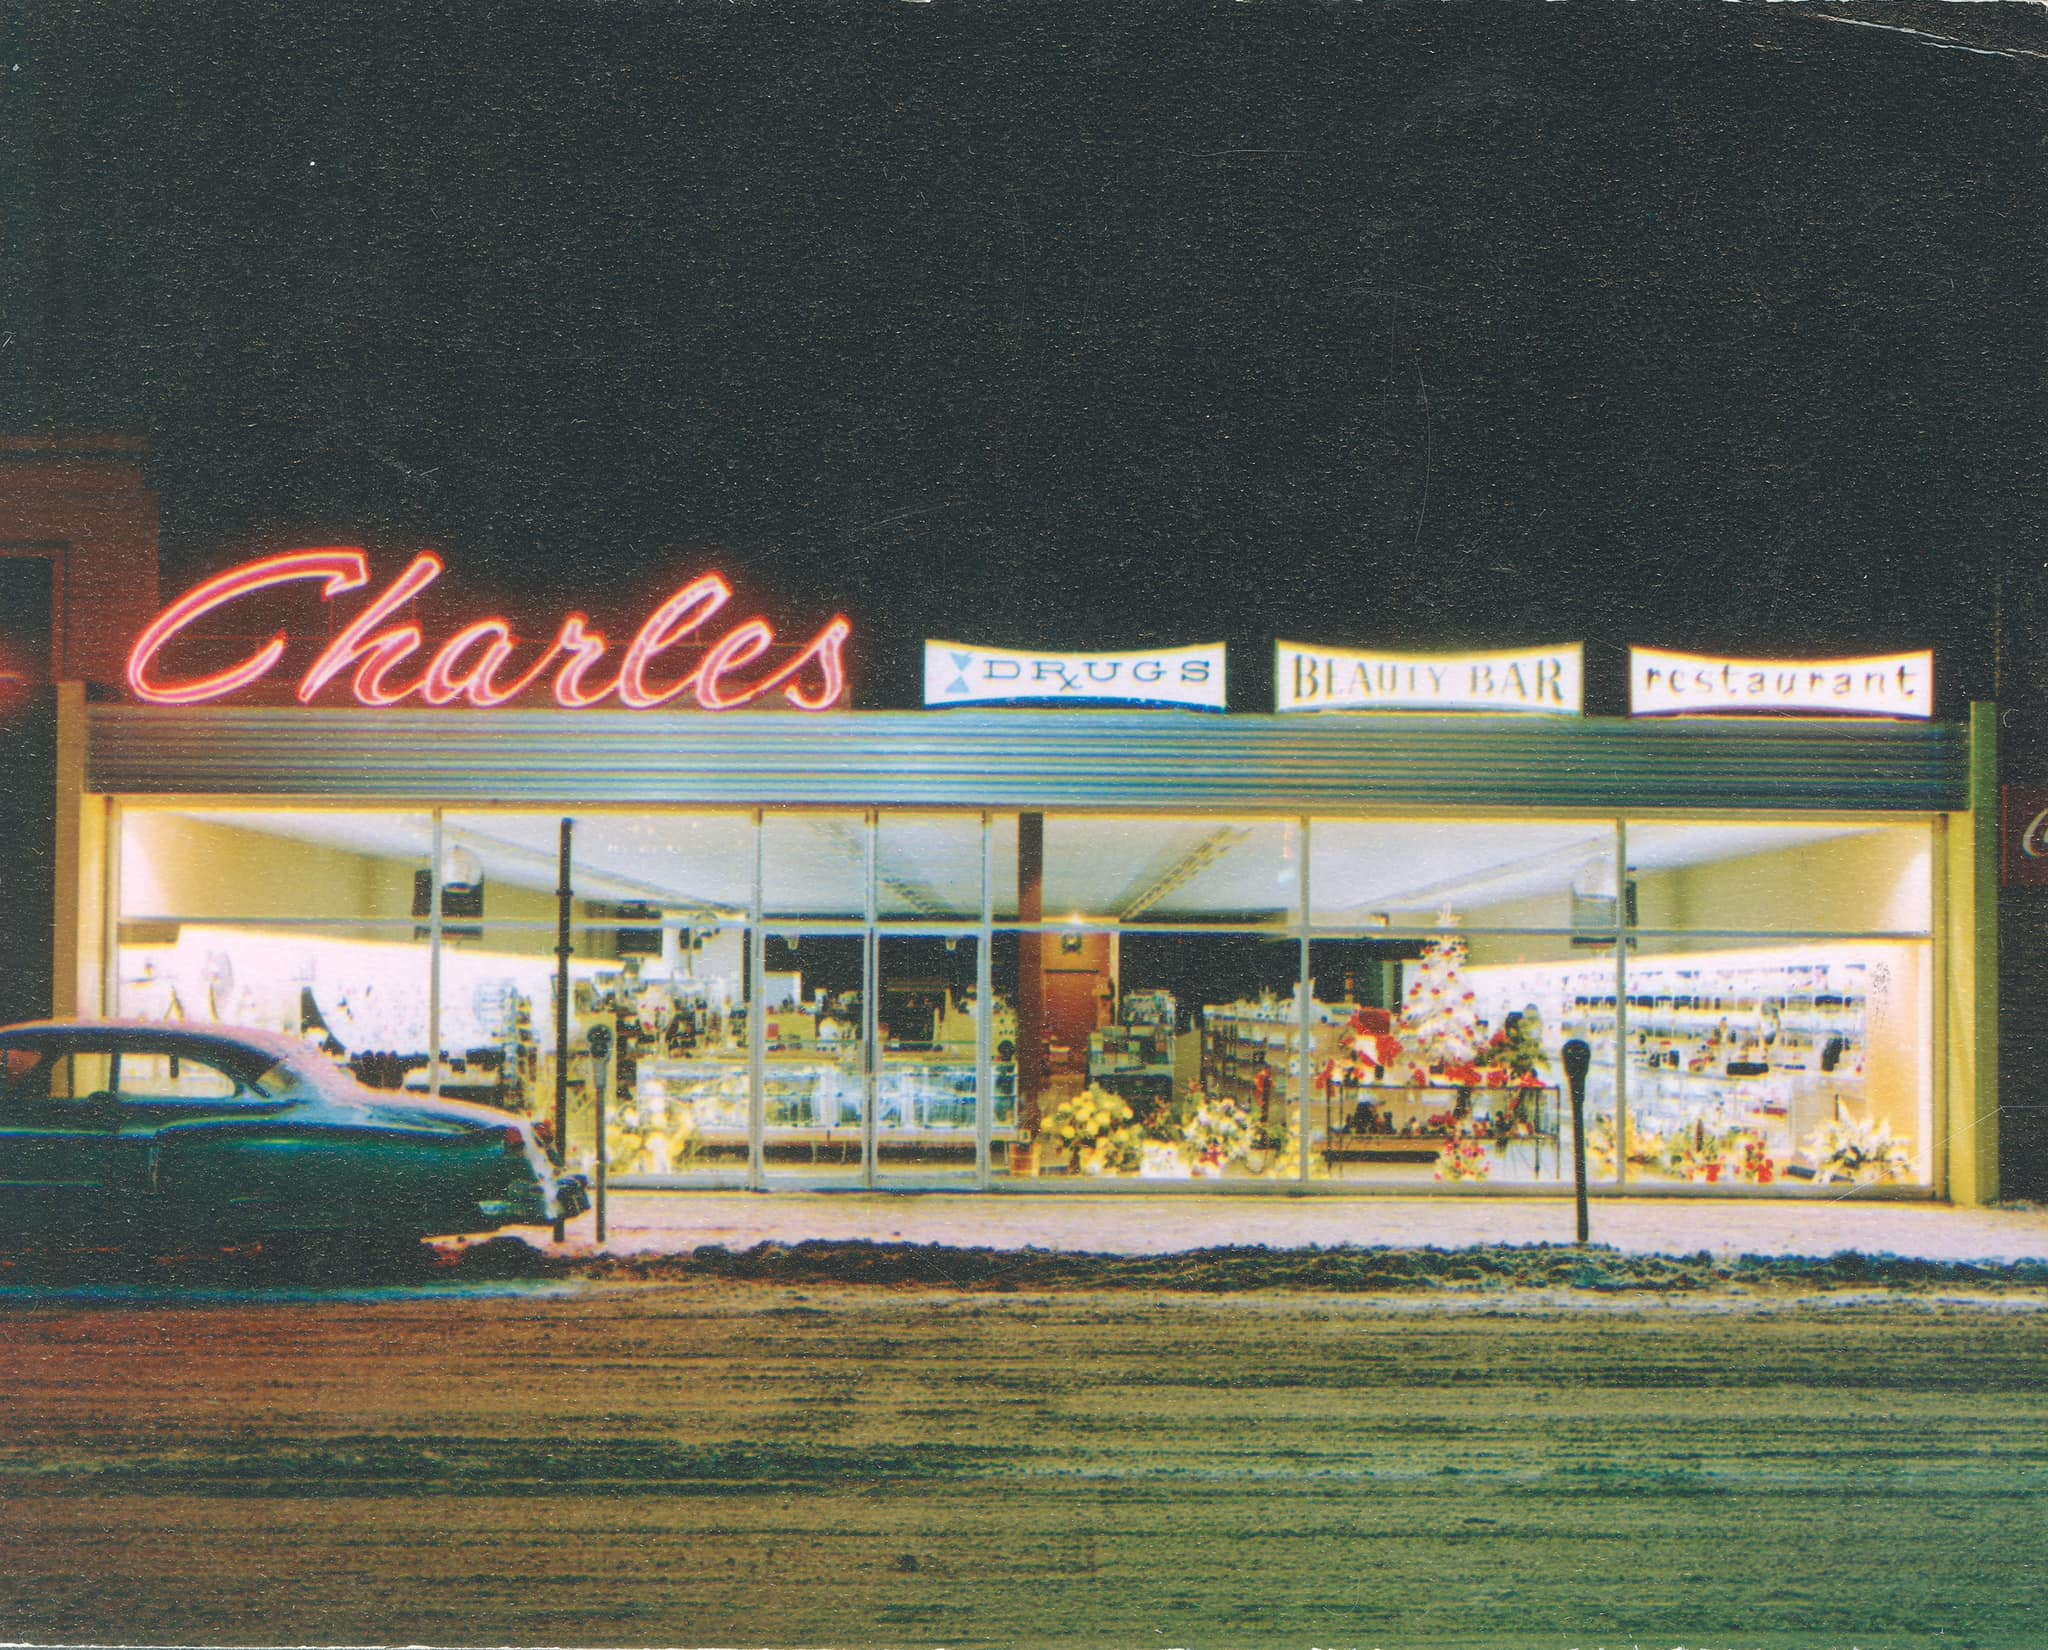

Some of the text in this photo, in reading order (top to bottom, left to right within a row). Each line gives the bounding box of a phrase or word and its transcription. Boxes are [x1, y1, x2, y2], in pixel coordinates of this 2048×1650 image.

[128, 547, 850, 707] Charles
[984, 660, 1210, 690] DRUGS
[1470, 658, 1564, 703] BAR
[1646, 663, 1917, 696] restaurant
